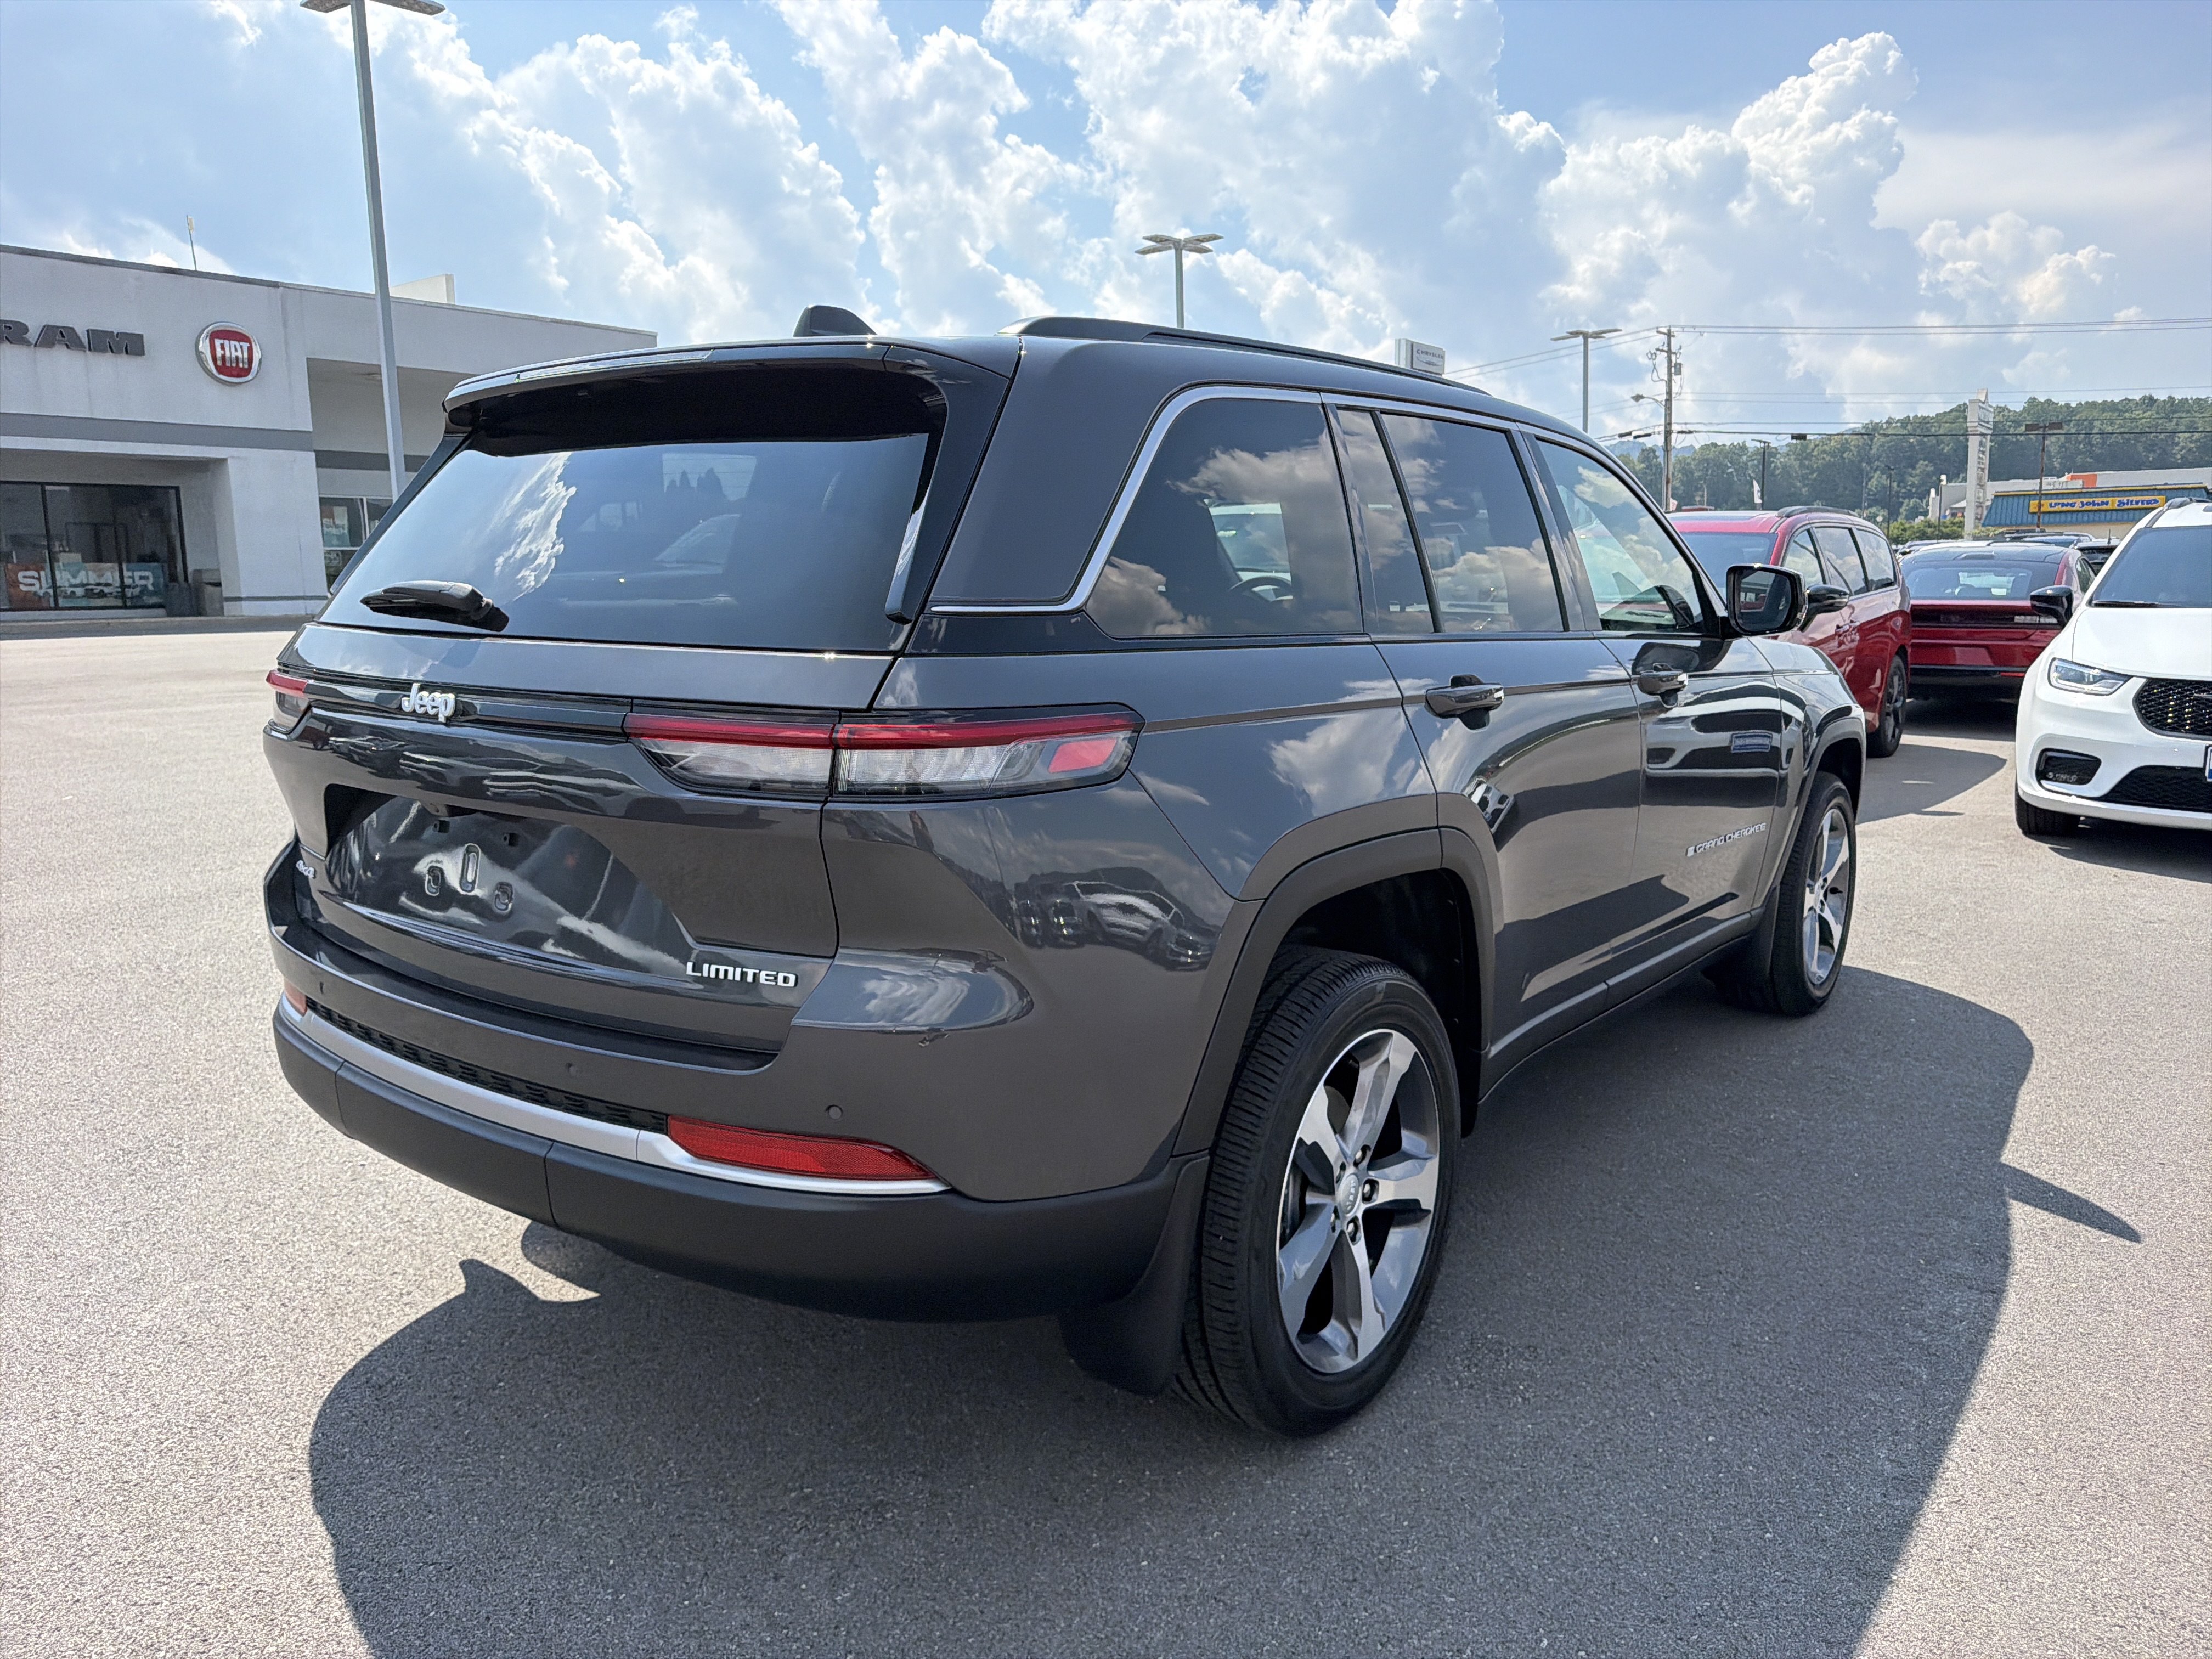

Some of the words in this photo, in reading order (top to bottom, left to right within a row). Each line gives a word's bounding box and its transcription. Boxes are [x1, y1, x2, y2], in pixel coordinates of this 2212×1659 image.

[0, 319, 145, 356] RAM
[214, 338, 250, 369] FIAT
[1417, 349, 1444, 360] CHRYSLER
[401, 682, 456, 723] Jeep
[1696, 835, 1725, 853] GRAND
[1725, 822, 1767, 843] CHEROKEE
[686, 961, 797, 988] LIMITED
